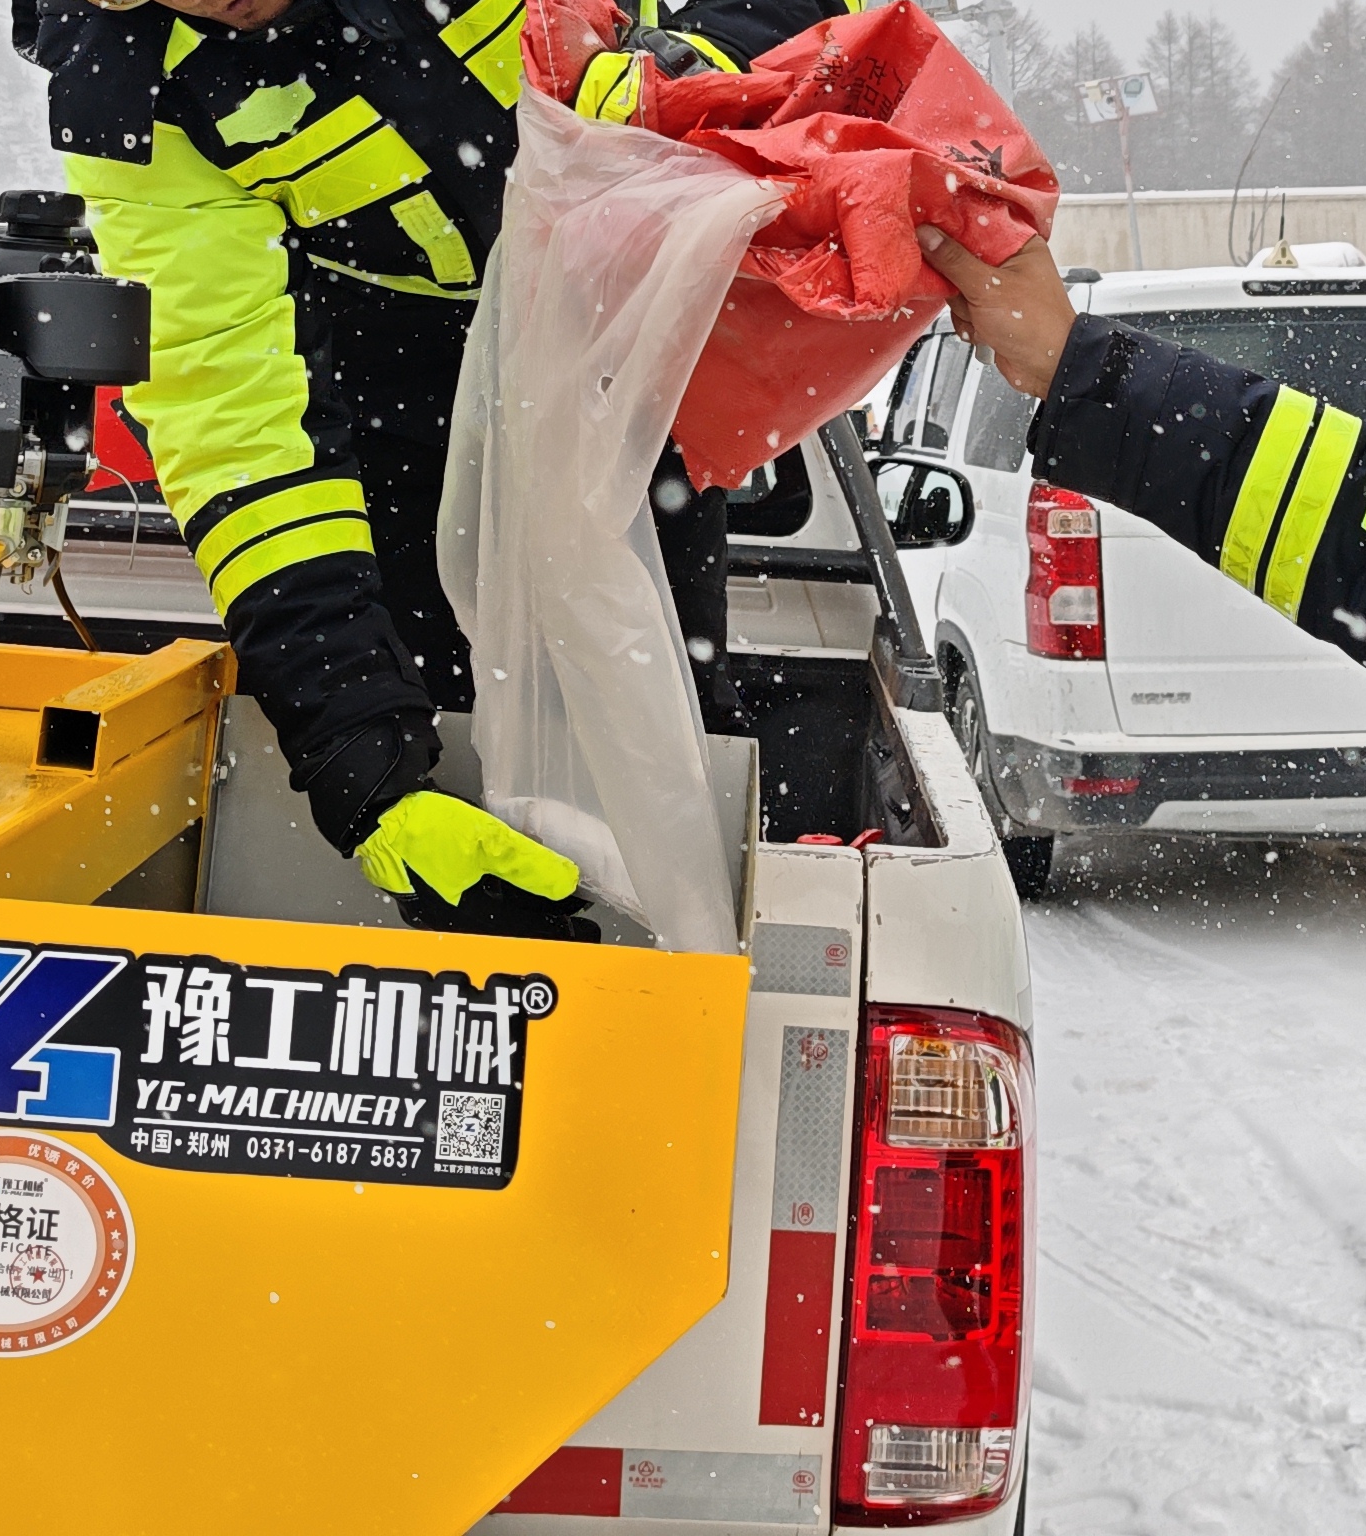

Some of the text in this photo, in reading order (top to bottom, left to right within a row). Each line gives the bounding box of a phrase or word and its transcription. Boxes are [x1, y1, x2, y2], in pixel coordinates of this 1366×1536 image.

[140, 965, 521, 1085] 豫工机械
[246, 1136, 362, 1166] 0371-6187
[370, 1145, 422, 1169] 5837
